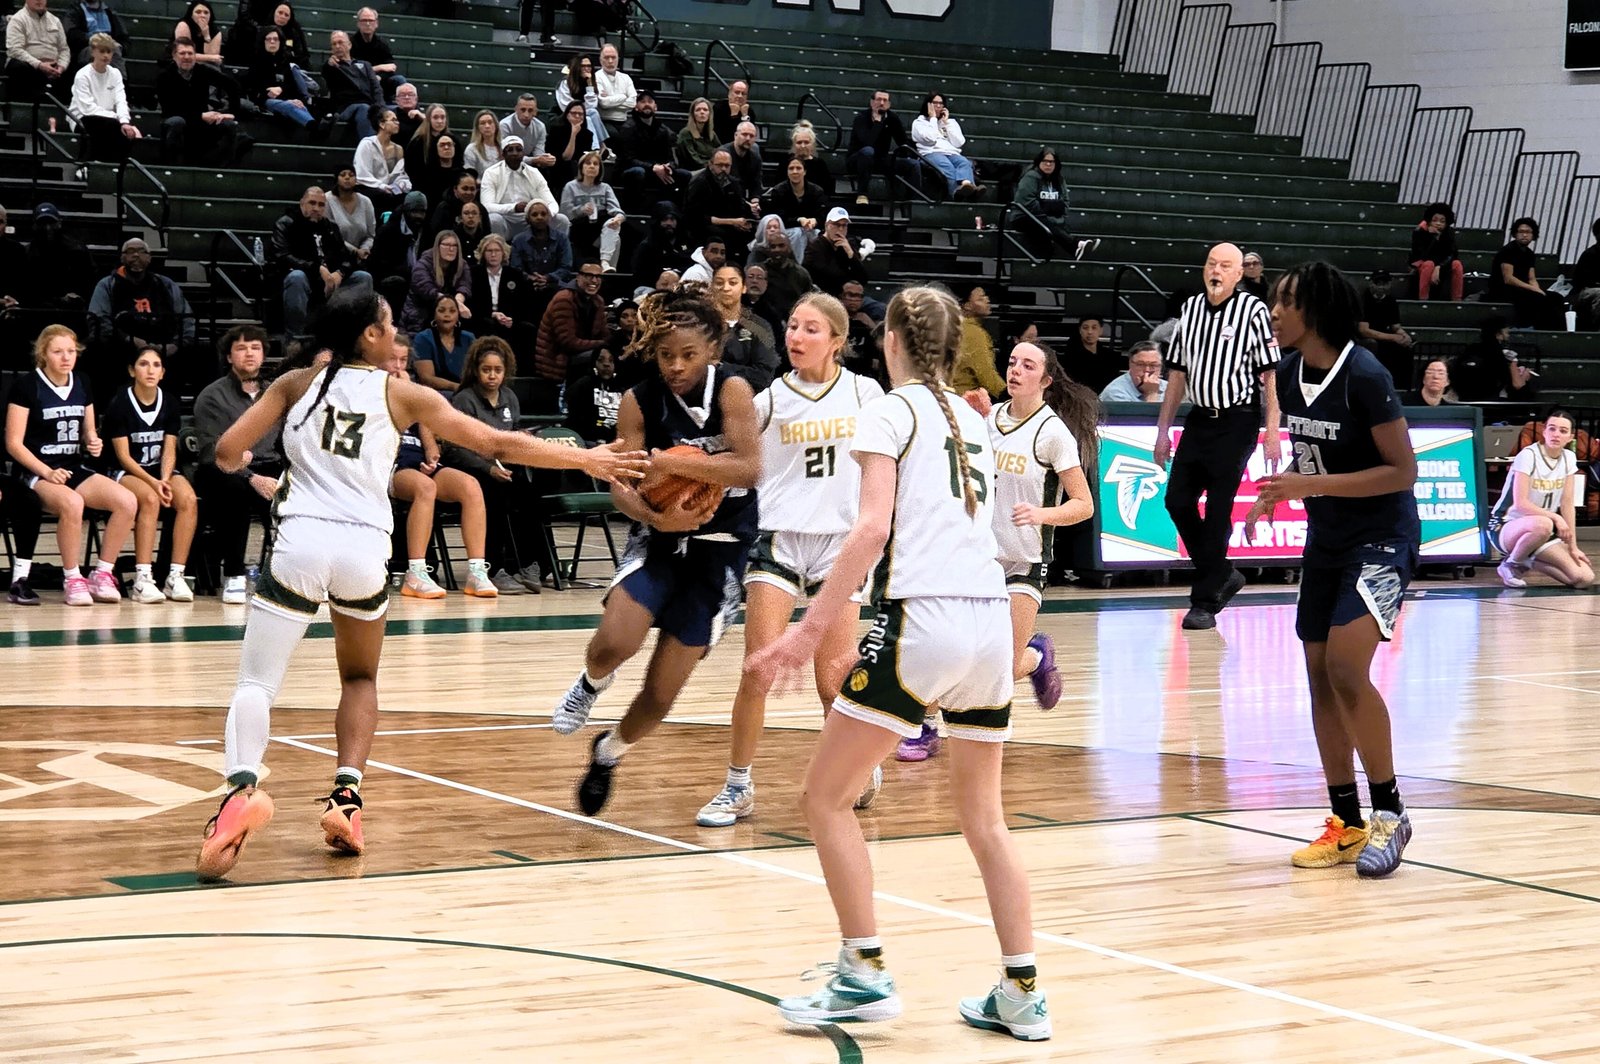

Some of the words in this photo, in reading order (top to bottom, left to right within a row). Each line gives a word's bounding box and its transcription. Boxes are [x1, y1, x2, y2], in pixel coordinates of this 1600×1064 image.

[1569, 22, 1600, 33] FALCON
[56, 420, 80, 443] 22
[321, 404, 367, 460] 13
[780, 416, 857, 445] GROVES
[1287, 415, 1341, 440] ETROIT
[804, 445, 836, 478] 21
[944, 436, 987, 505] 15
[994, 450, 1028, 475] VES
[1294, 441, 1328, 475] 21
[1416, 460, 1461, 477] HOME
[1414, 481, 1434, 499] OF
[1435, 481, 1467, 499] THE
[1532, 478, 1565, 491] GROVE
[1416, 503, 1476, 520] ALCONS
